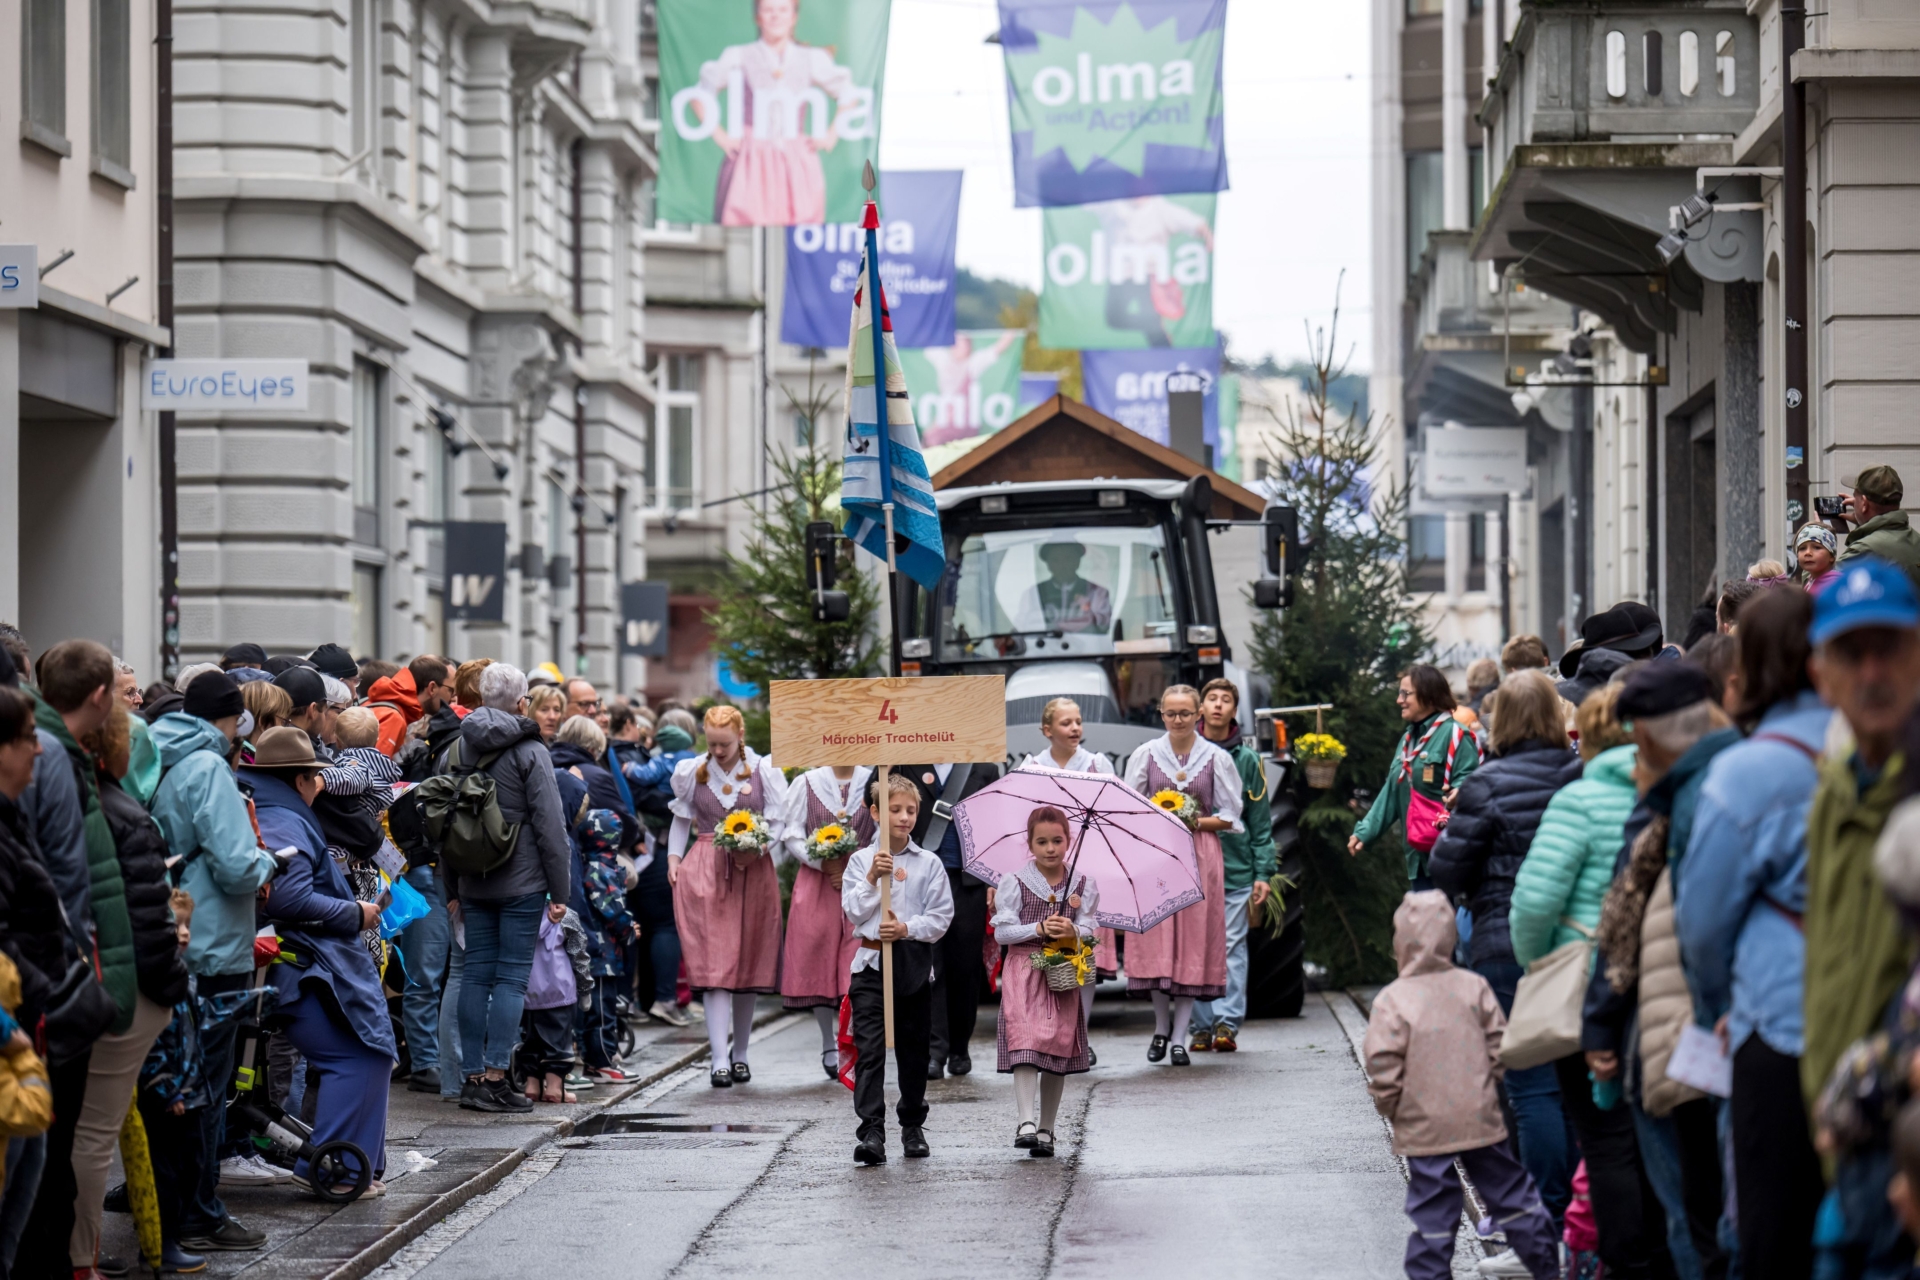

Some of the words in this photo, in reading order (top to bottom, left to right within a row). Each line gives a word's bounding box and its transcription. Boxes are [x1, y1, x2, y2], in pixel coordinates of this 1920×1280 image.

[1032, 52, 1194, 105] olma
[671, 68, 874, 141] olma
[1087, 101, 1190, 132] Action!
[1046, 230, 1208, 287] olma
[151, 370, 295, 401] EuroEyes
[878, 699, 898, 724] 4
[822, 733, 882, 745] Märchler
[885, 731, 955, 744] Trachtelüt
